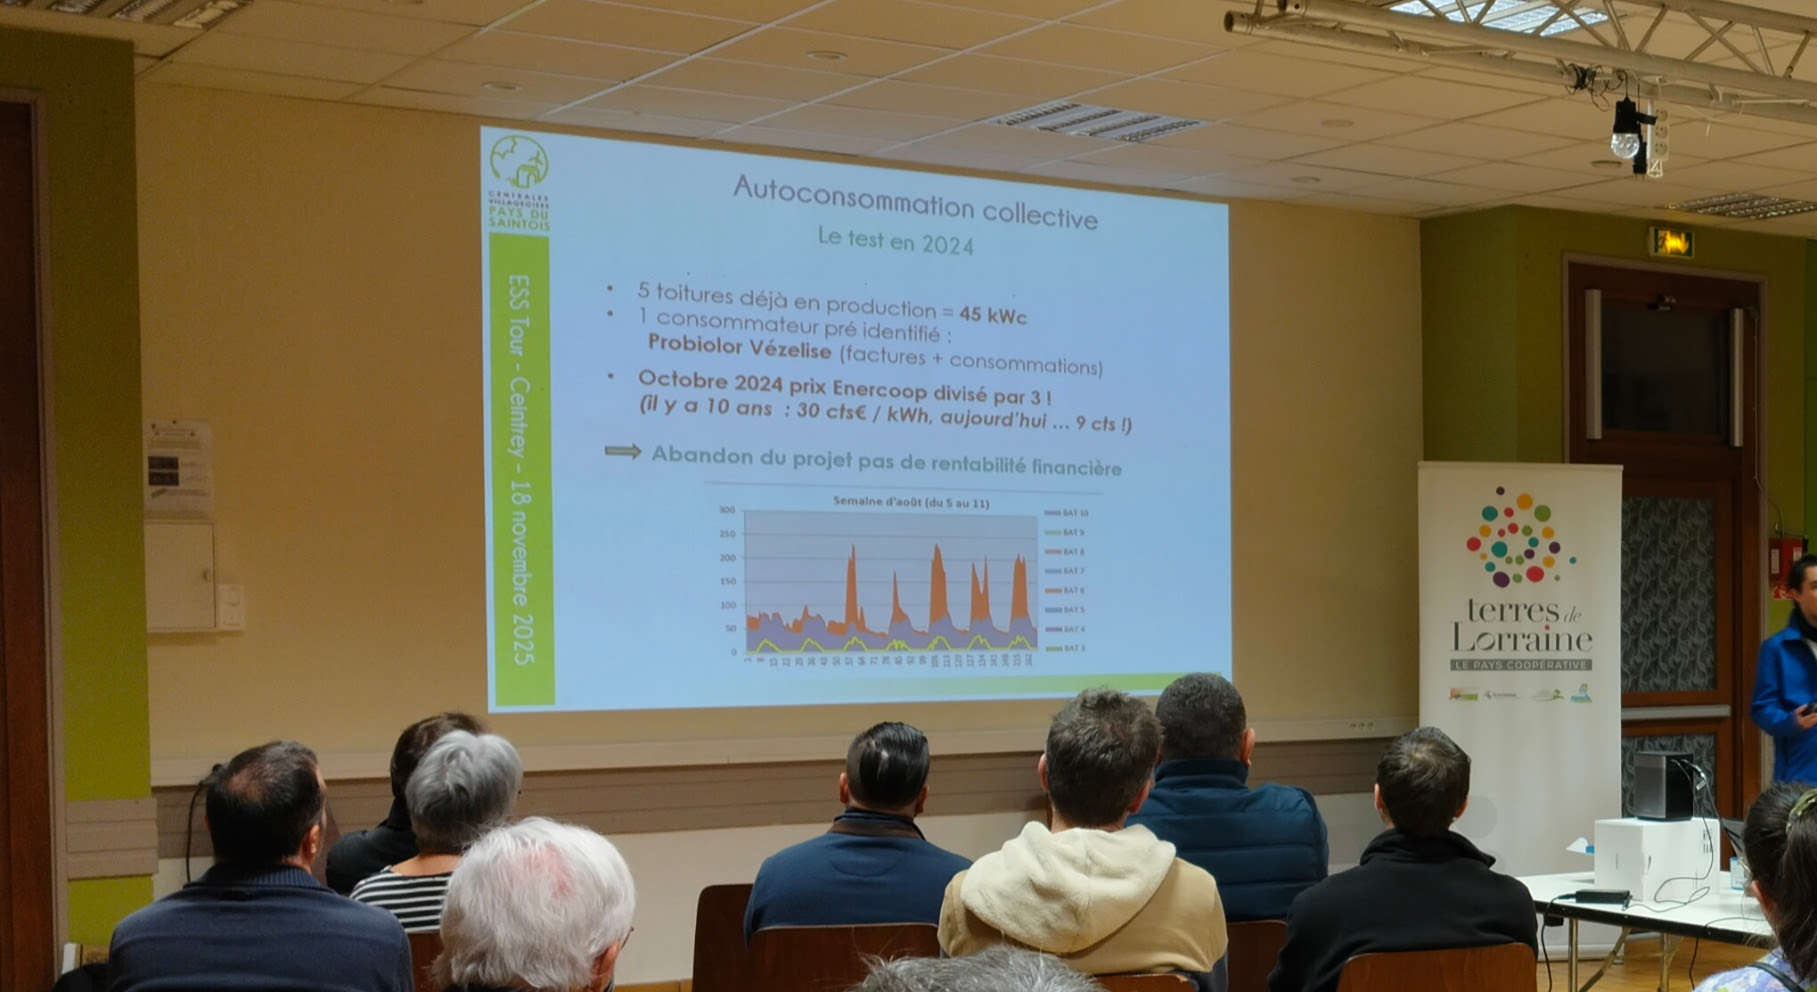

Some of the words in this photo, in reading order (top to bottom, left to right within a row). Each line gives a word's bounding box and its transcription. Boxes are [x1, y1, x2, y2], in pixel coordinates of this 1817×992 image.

[489, 205, 523, 218] PAYS
[531, 209, 548, 220] DU
[733, 174, 975, 220] Autoconsommation
[983, 201, 1099, 231] collective
[489, 216, 550, 231] SAINTOIS
[818, 225, 842, 246] Le
[849, 229, 884, 249] test
[890, 237, 915, 252] en
[923, 234, 974, 256] 2024
[508, 274, 530, 309] ESS
[638, 282, 650, 299] 5
[657, 283, 734, 305] toitures
[740, 289, 787, 311] déjà
[794, 299, 820, 312] en
[827, 299, 937, 319] production
[942, 307, 954, 317] =
[959, 306, 981, 322] 45
[988, 307, 1028, 326] kWc
[508, 317, 530, 358] Tour
[640, 307, 647, 324] 1
[657, 311, 819, 335] consommateur
[825, 321, 857, 340] pré
[862, 323, 941, 343] identifié
[649, 333, 743, 354] Probiolor
[750, 339, 832, 359] Vézelise
[840, 345, 926, 366] (factures
[932, 353, 943, 364] +
[950, 353, 1103, 379] consommations)
[638, 369, 728, 389] Octobre
[735, 374, 783, 393] 2024
[789, 377, 827, 398] prix
[833, 380, 927, 403] Enercoop
[934, 384, 987, 403] divisé
[994, 391, 1025, 407] par
[1030, 390, 1041, 405] 3
[1047, 391, 1052, 406] !
[508, 376, 531, 463] Ceintrey
[640, 394, 658, 415] (il
[665, 399, 677, 416] y
[684, 399, 698, 413] a
[708, 397, 729, 414] 10
[737, 402, 772, 416] ans
[797, 402, 820, 418] 30
[826, 403, 867, 420] cts€
[872, 406, 881, 423] /
[887, 406, 933, 425] kWh,
[941, 409, 1047, 429] aujourd'hui
[1076, 416, 1086, 431] 9
[1091, 416, 1116, 432] cts
[1121, 416, 1132, 436] !)
[652, 445, 753, 465] Abandon
[760, 449, 786, 466] du
[793, 451, 852, 472] projet
[859, 456, 894, 472] pas
[901, 454, 926, 470] de
[932, 455, 1026, 474] rentabilité
[1032, 458, 1123, 477] financière
[510, 480, 532, 505] 18
[833, 496, 882, 506] Semaine
[925, 497, 943, 509] (du
[956, 500, 969, 508] au
[973, 498, 990, 510] 11)
[720, 530, 736, 538] 250
[511, 511, 534, 607] novembre
[720, 554, 736, 562] 200
[720, 577, 736, 585] 150
[721, 601, 736, 609] 100
[1467, 598, 1560, 622] terres
[1563, 606, 1582, 623] de
[513, 616, 535, 667] 2025
[726, 625, 736, 633] 50
[1450, 621, 1593, 651] Lorraine
[1455, 661, 1470, 670] LE
[1473, 661, 1503, 670] PAYS
